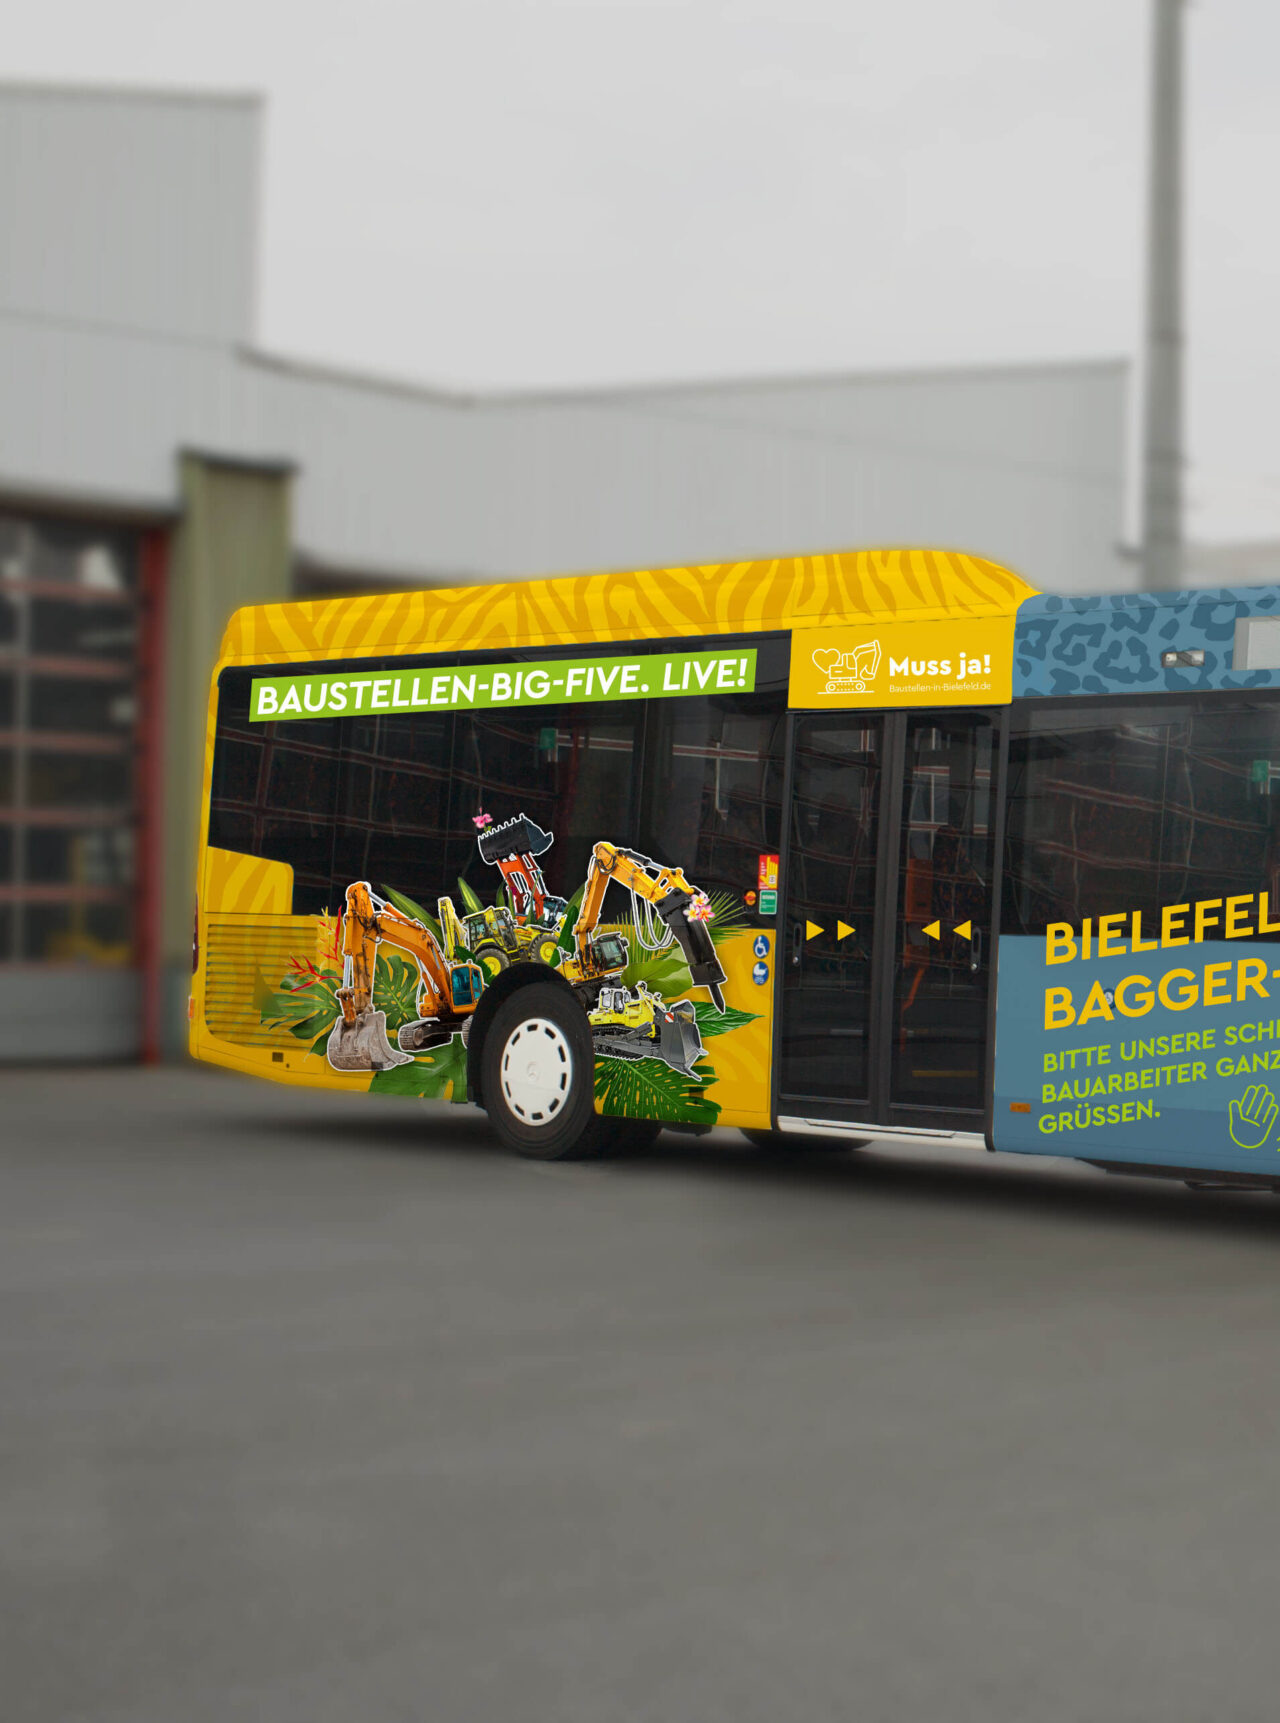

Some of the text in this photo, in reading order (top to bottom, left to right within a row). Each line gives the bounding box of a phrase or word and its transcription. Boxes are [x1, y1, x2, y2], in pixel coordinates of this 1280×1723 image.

[888, 651, 992, 681] Muss ja!
[257, 658, 748, 715] BAUSTELLEN-BIG-FIVE. LIVE!
[889, 681, 992, 693] Baustellen-in-Bielefeld.de
[1043, 1044, 1111, 1074] BITTE
[1120, 1028, 1216, 1061] UNSERE
[1041, 1061, 1208, 1104] BAUARBEITER
[1038, 1099, 1161, 1134] GRÜSSEN.
